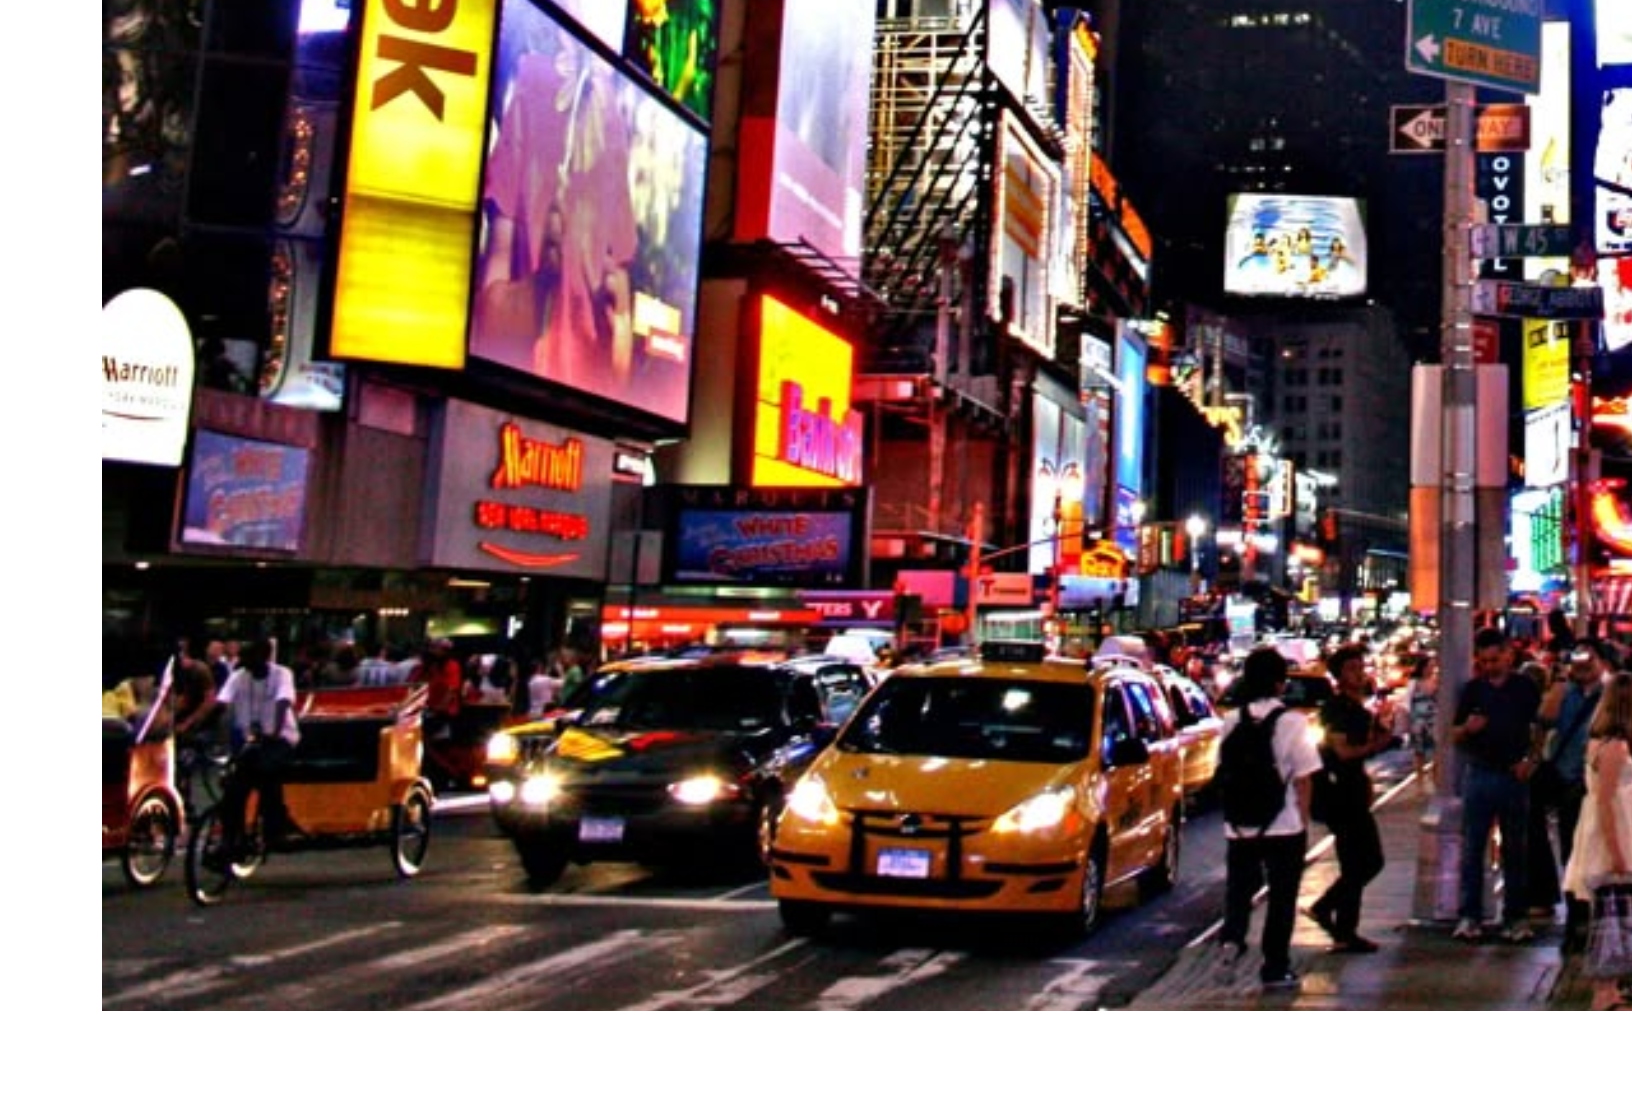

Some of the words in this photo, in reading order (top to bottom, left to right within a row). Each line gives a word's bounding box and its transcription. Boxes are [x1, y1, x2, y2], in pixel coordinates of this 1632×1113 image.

[1452, 8, 1464, 29] 7
[1471, 13, 1503, 40] AVE
[1447, 40, 1490, 68] TURN
[1414, 120, 1446, 136] ON
